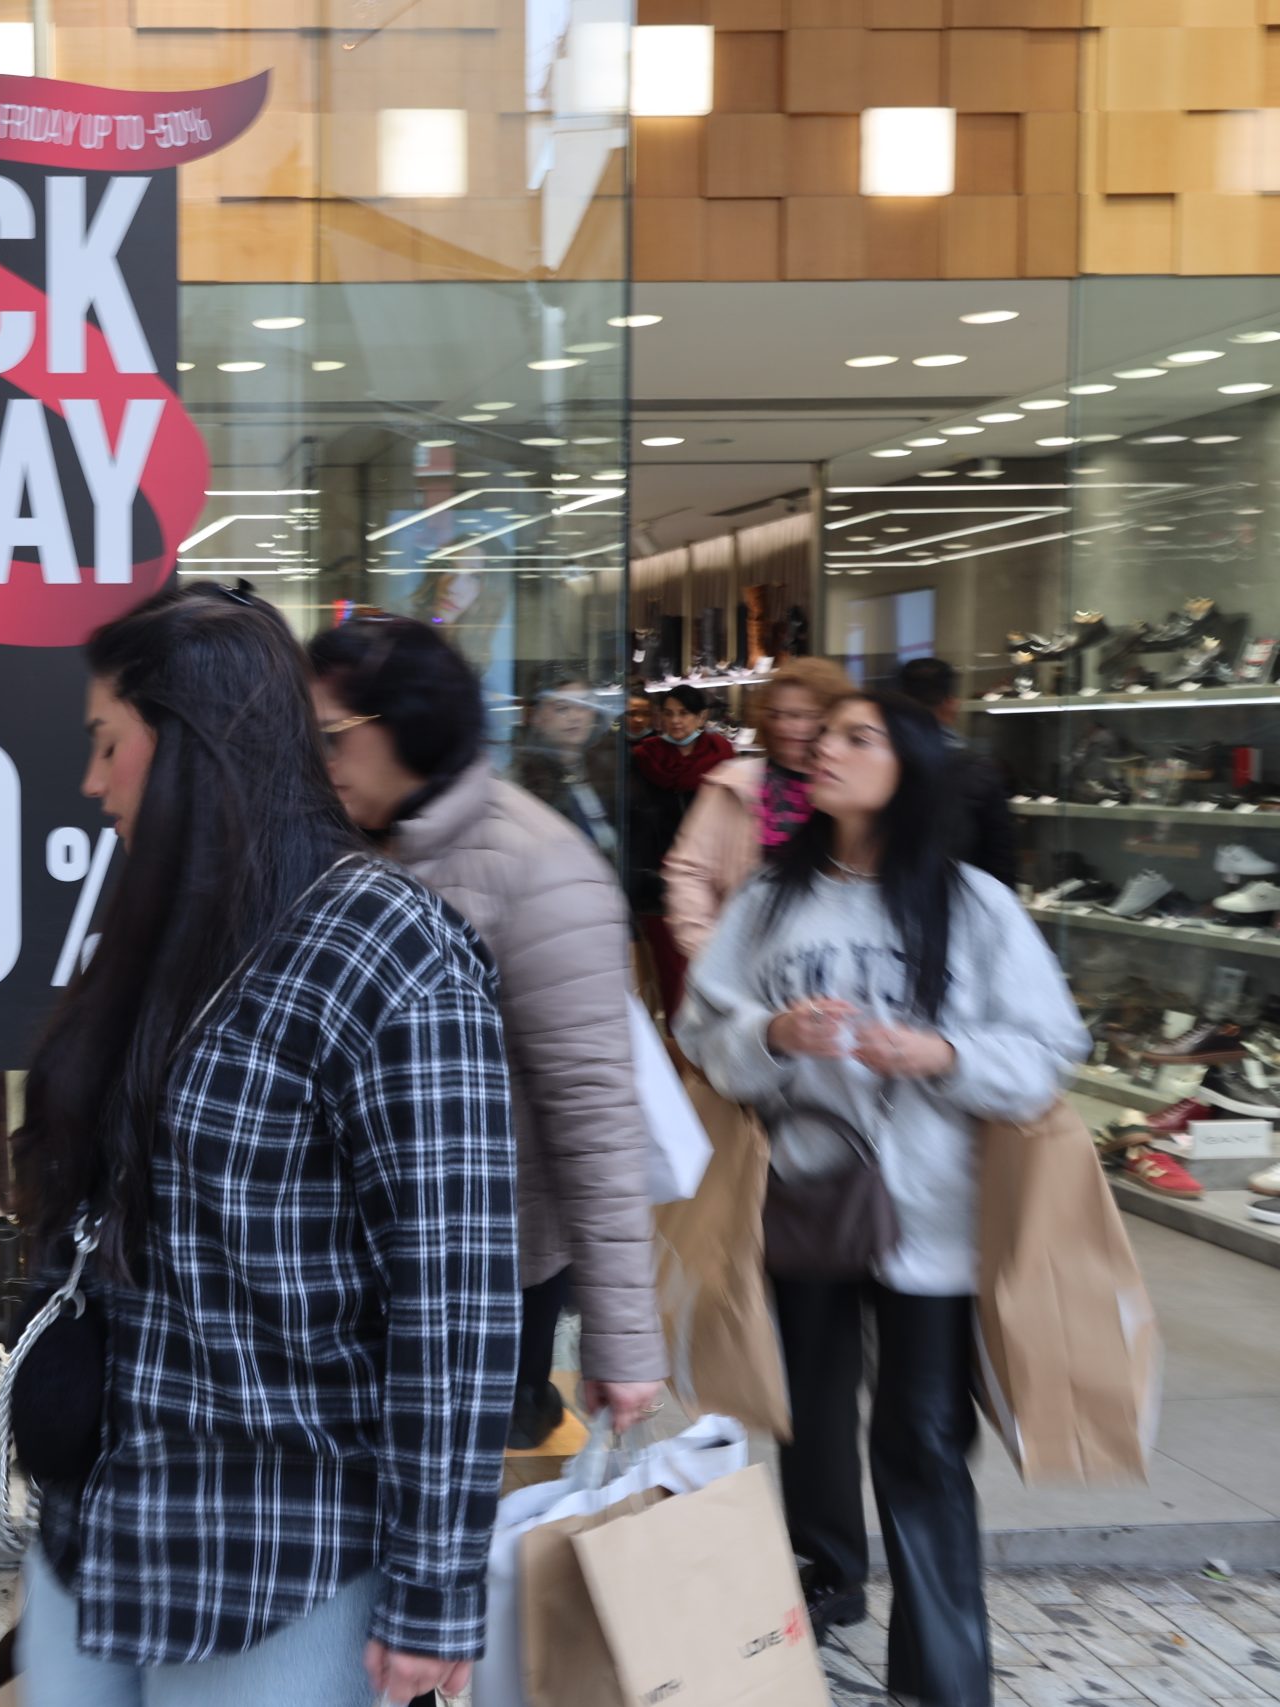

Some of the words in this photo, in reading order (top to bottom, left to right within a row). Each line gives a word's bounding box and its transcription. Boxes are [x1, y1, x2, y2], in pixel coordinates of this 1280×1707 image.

[79, 114, 111, 149] UP
[113, 114, 144, 150] TO
[146, 107, 212, 148] -50%
